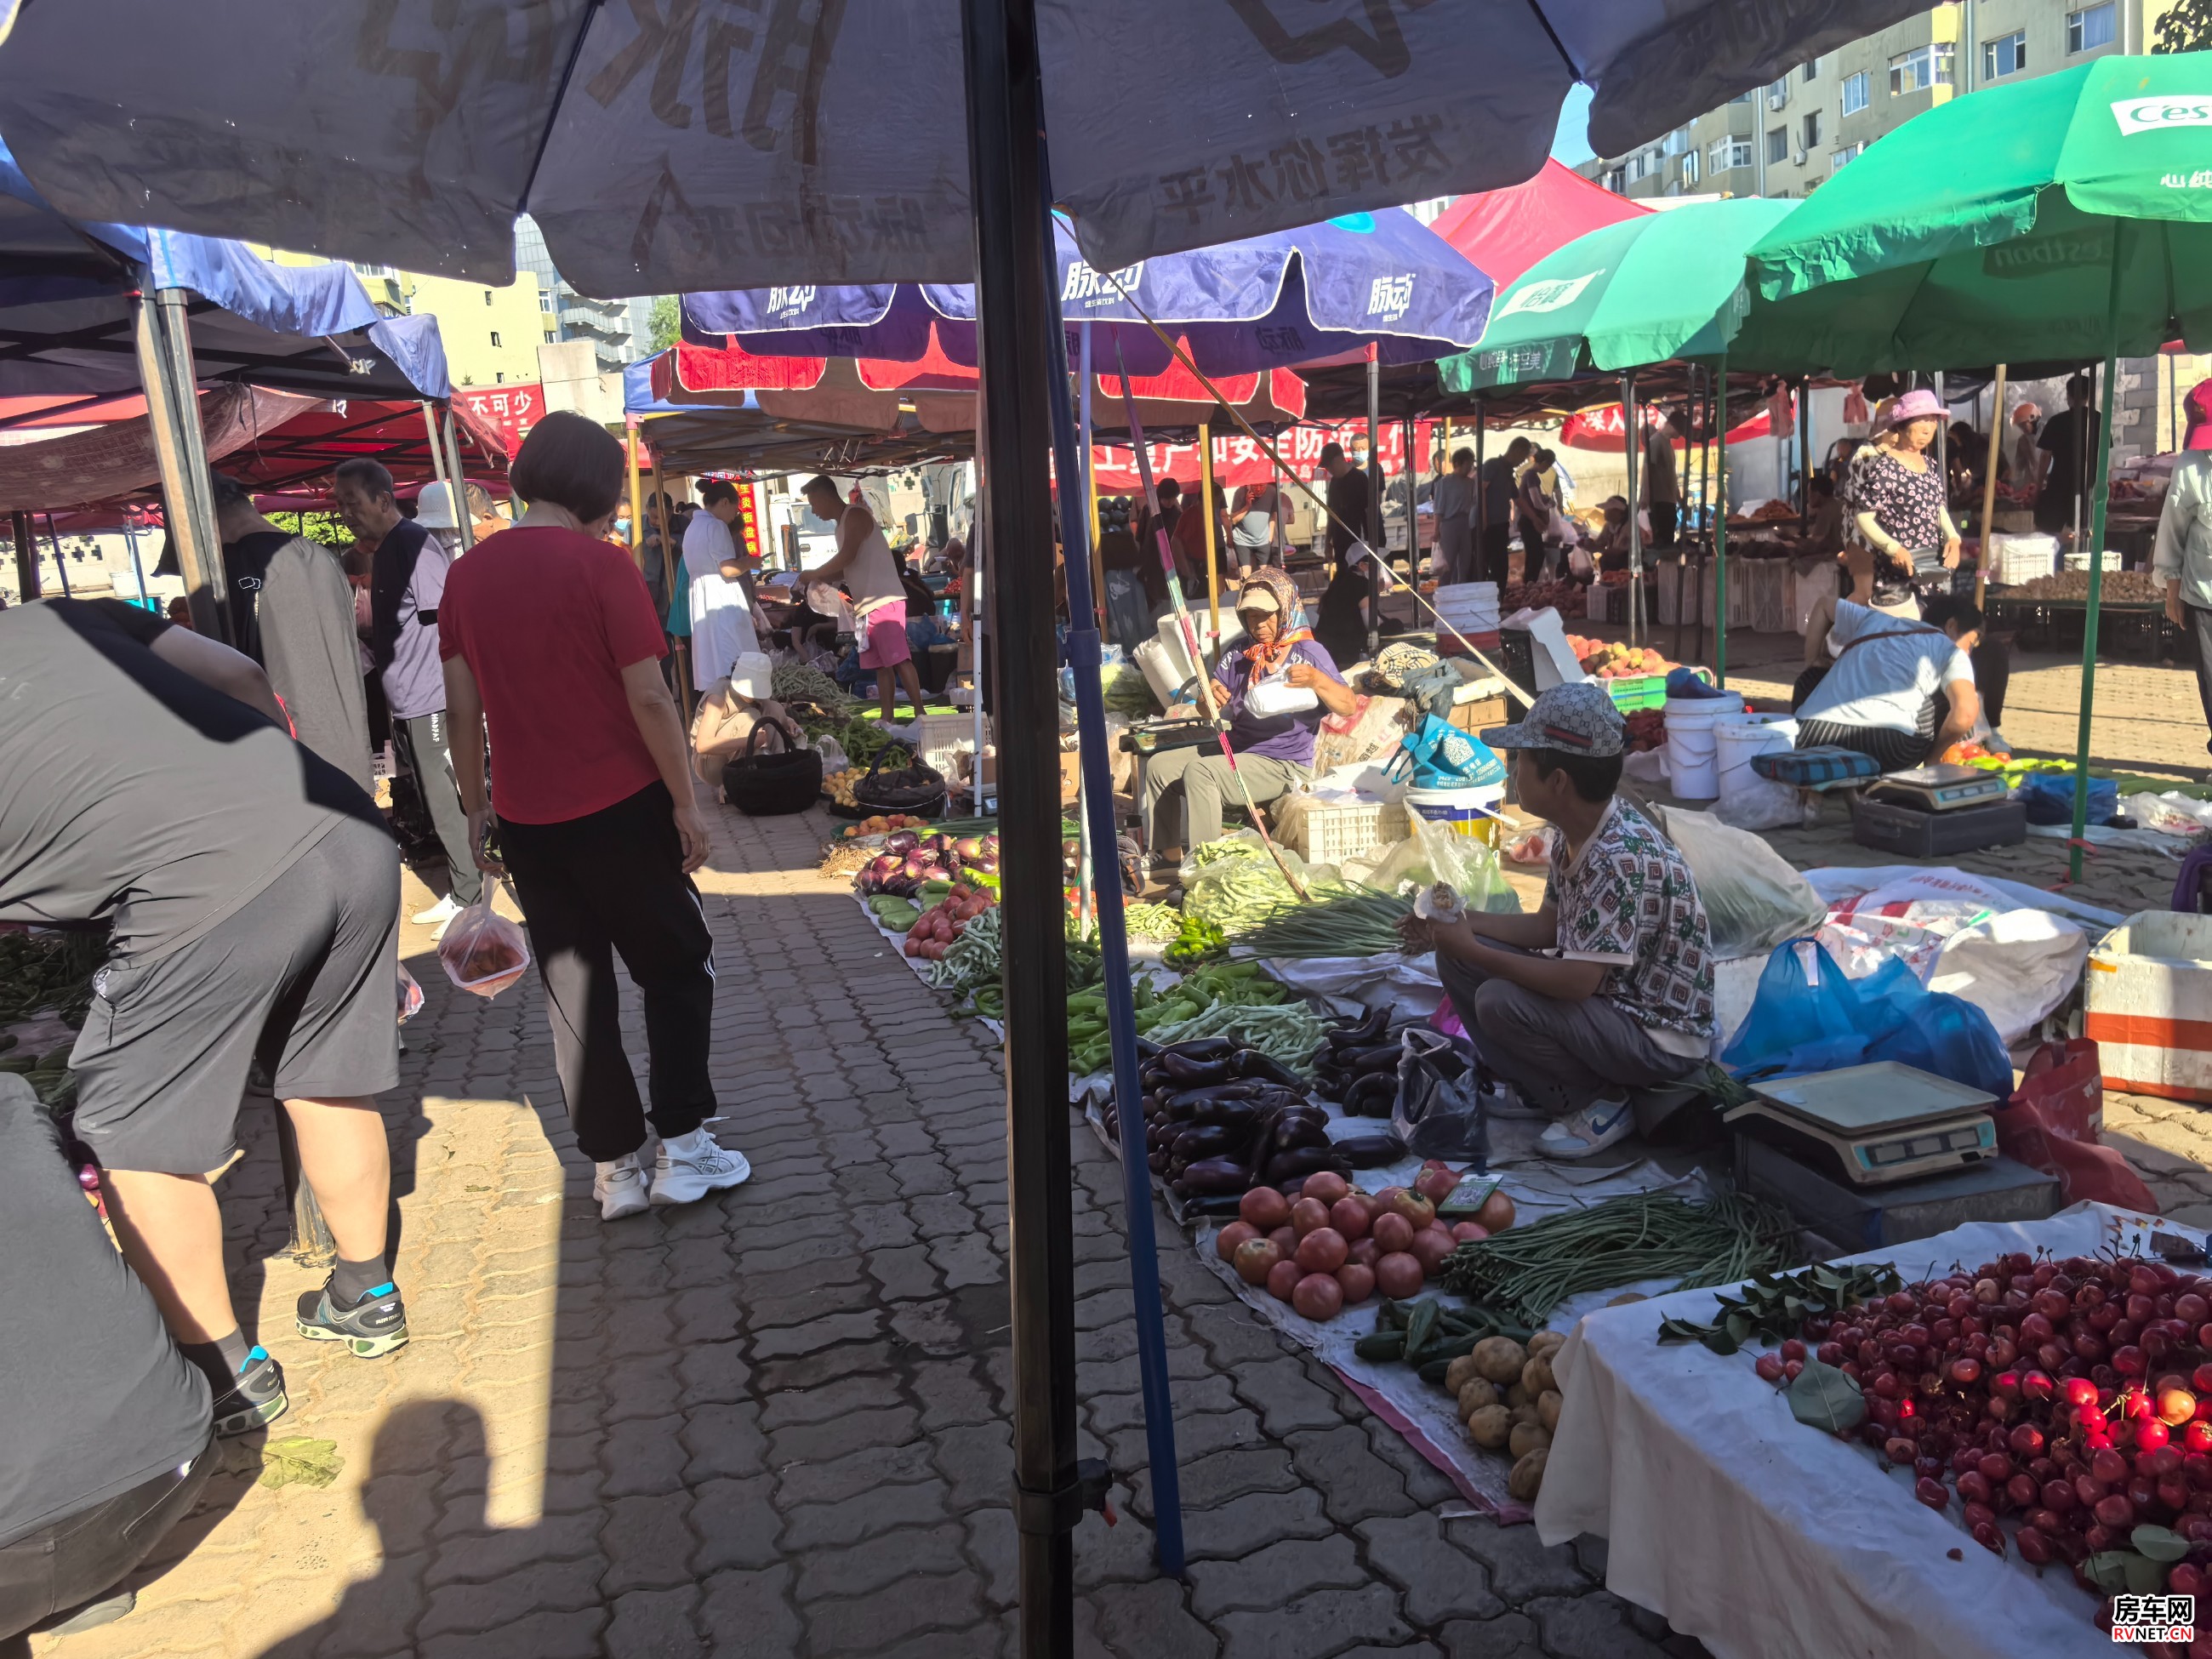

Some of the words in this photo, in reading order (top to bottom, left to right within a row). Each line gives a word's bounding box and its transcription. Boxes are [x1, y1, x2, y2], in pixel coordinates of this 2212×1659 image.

[1366, 273, 1413, 319] 脉动
[470, 390, 533, 418] 不可少
